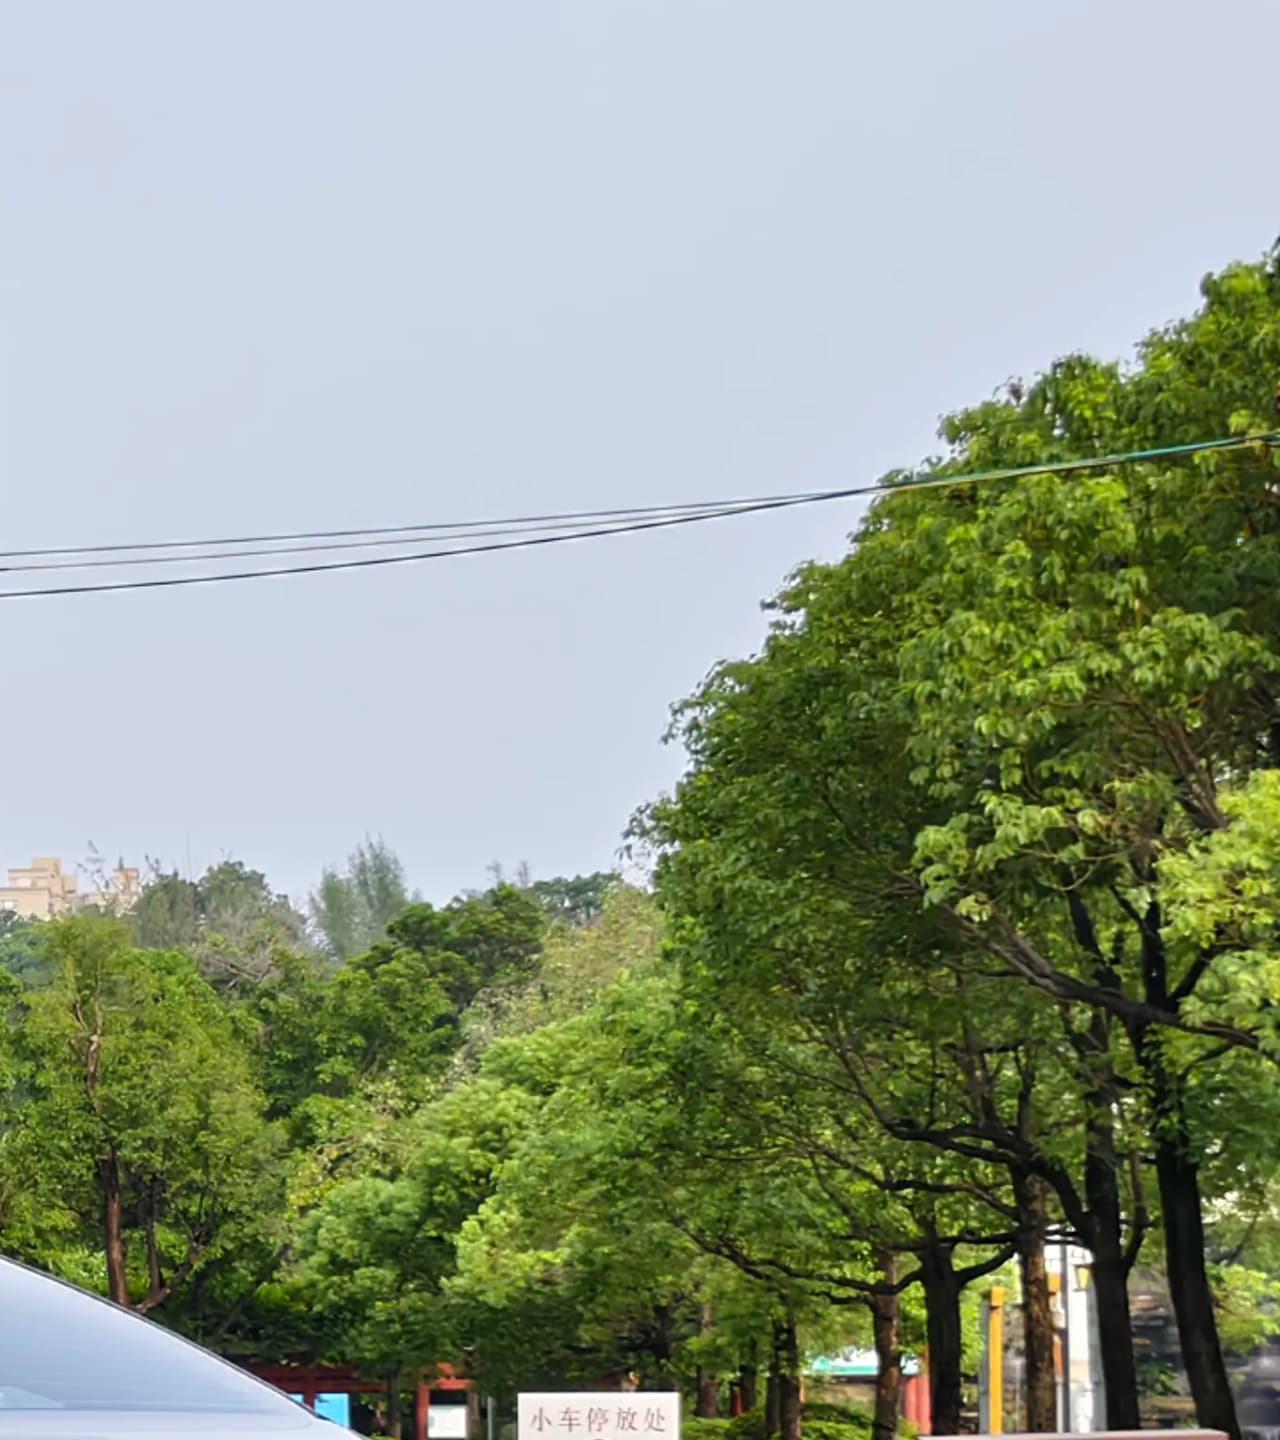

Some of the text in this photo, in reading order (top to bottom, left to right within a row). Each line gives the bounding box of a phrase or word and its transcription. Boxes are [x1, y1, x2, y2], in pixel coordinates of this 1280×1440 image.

[529, 1406, 666, 1433] 小车停放处
